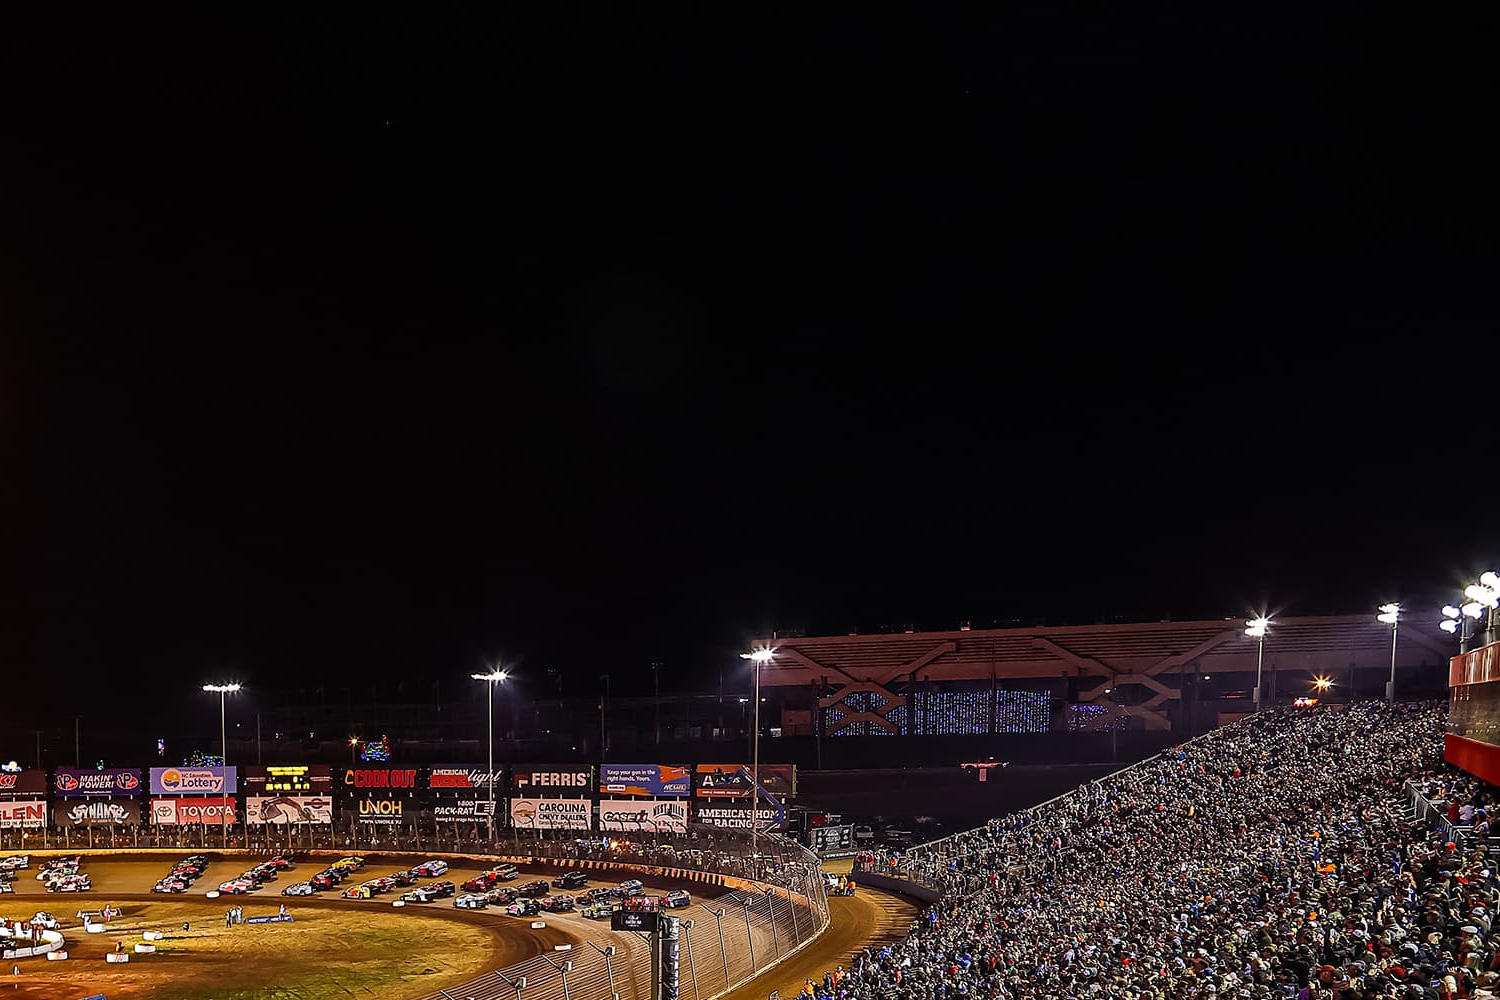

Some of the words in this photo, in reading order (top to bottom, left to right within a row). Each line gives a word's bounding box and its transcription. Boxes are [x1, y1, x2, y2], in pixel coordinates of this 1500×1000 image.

[182, 778, 222, 789] Lottery
[355, 770, 390, 787] COOK
[391, 770, 416, 787] OUT
[532, 773, 587, 786] FERRIS
[180, 806, 234, 816] TOYOTA
[359, 800, 402, 815] UNOH
[539, 803, 586, 812] CAROLINA
[603, 811, 637, 822] CASE
[698, 809, 752, 818] AMERICA'S
[714, 819, 752, 828] RACING
